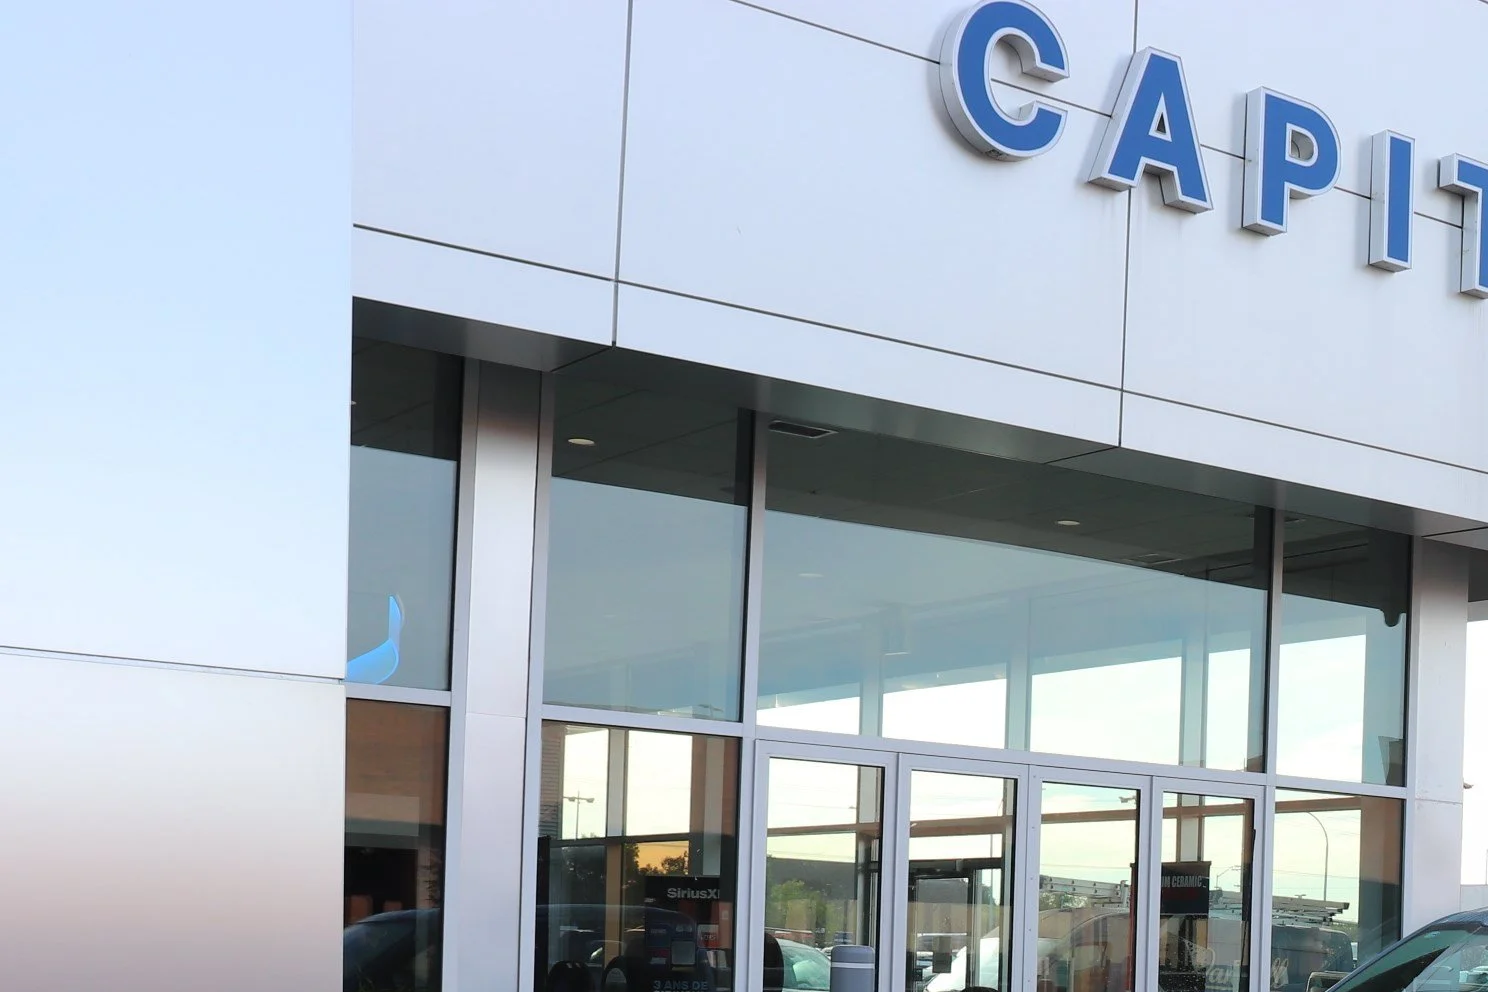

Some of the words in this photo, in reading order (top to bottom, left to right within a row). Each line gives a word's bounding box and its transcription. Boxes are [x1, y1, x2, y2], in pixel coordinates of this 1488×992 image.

[1171, 875, 1202, 888] CERAMIC
[667, 887, 720, 899] SiriusX
[653, 980, 660, 990] 3
[663, 980, 690, 990] ANS
[692, 981, 709, 990] DE
